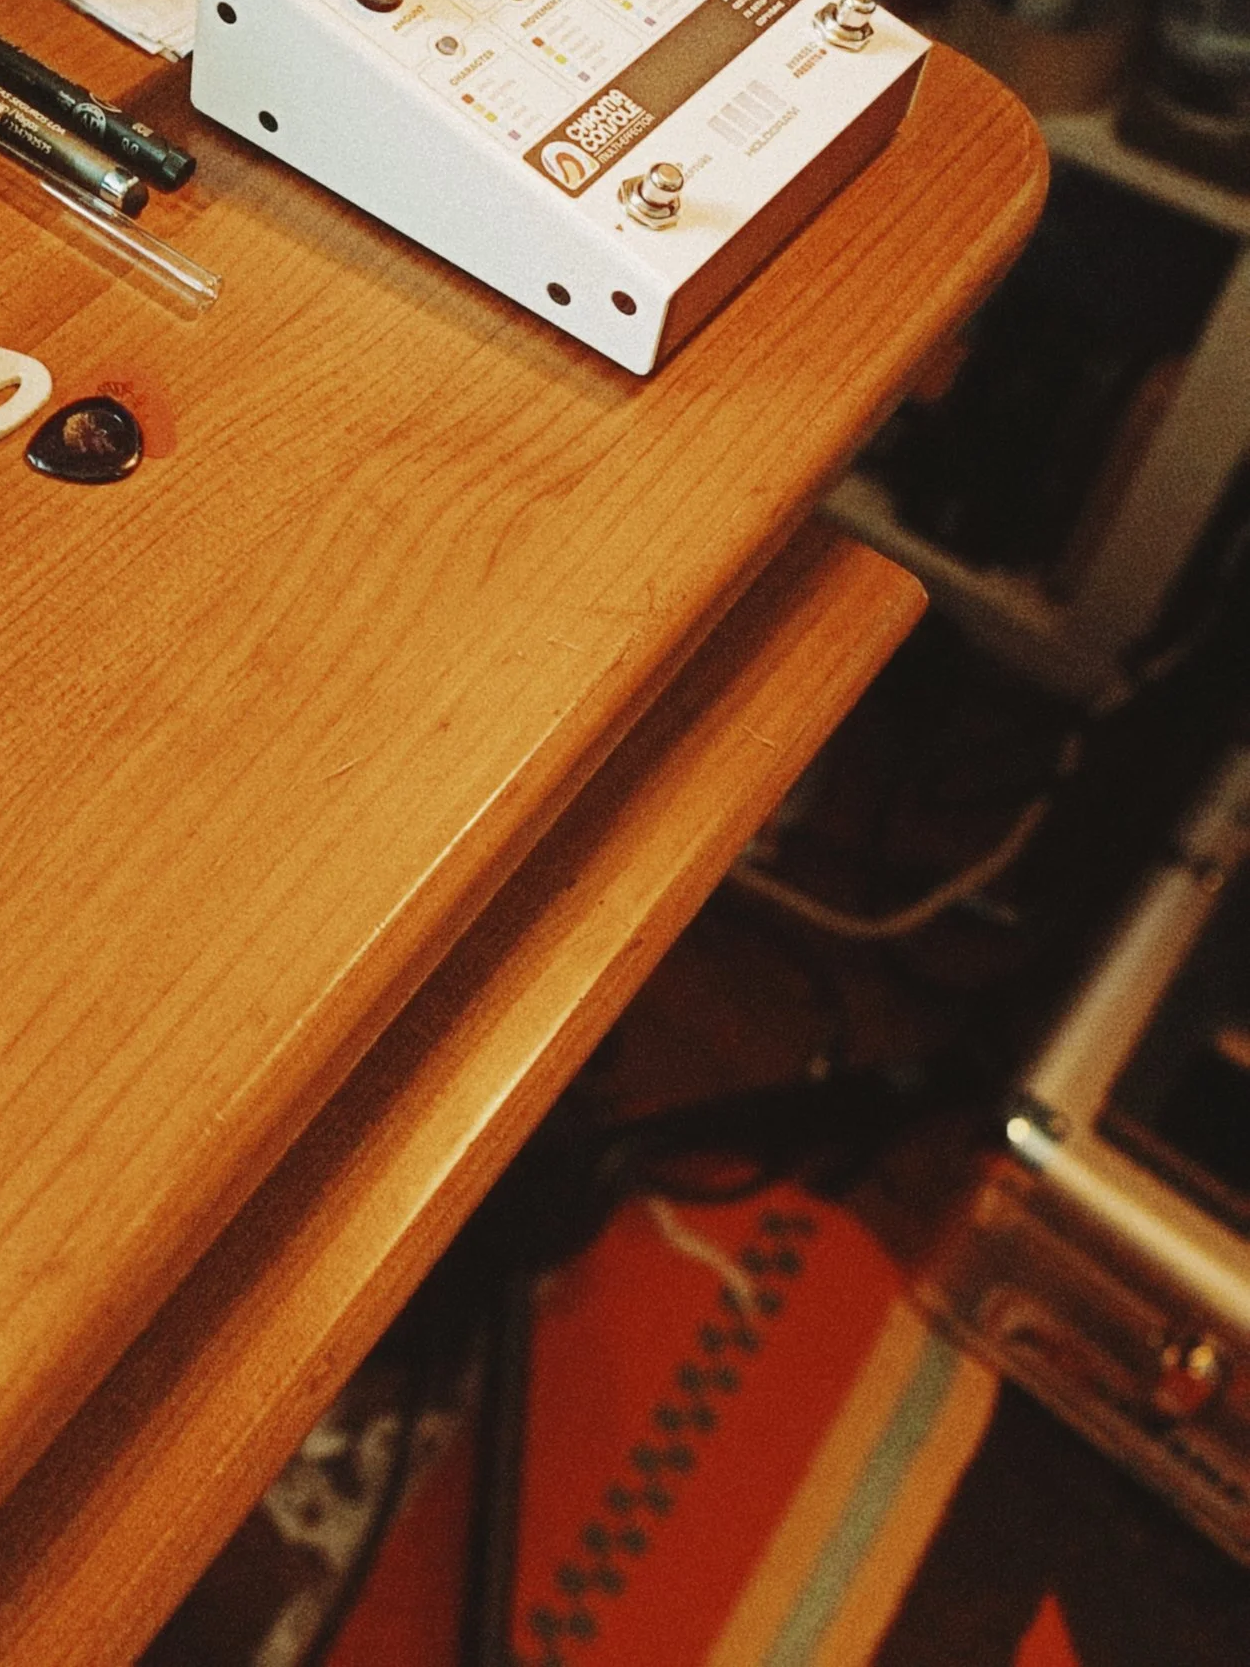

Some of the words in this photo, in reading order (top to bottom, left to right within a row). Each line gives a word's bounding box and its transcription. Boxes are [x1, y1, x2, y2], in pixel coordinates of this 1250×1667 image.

[449, 49, 496, 86] CHARACTER
[566, 88, 624, 141] CHROMA
[580, 101, 644, 153] CONSOLE
[597, 113, 656, 164] MULTI-EFFECTOR
[743, 105, 801, 157] HOLOGRAM
